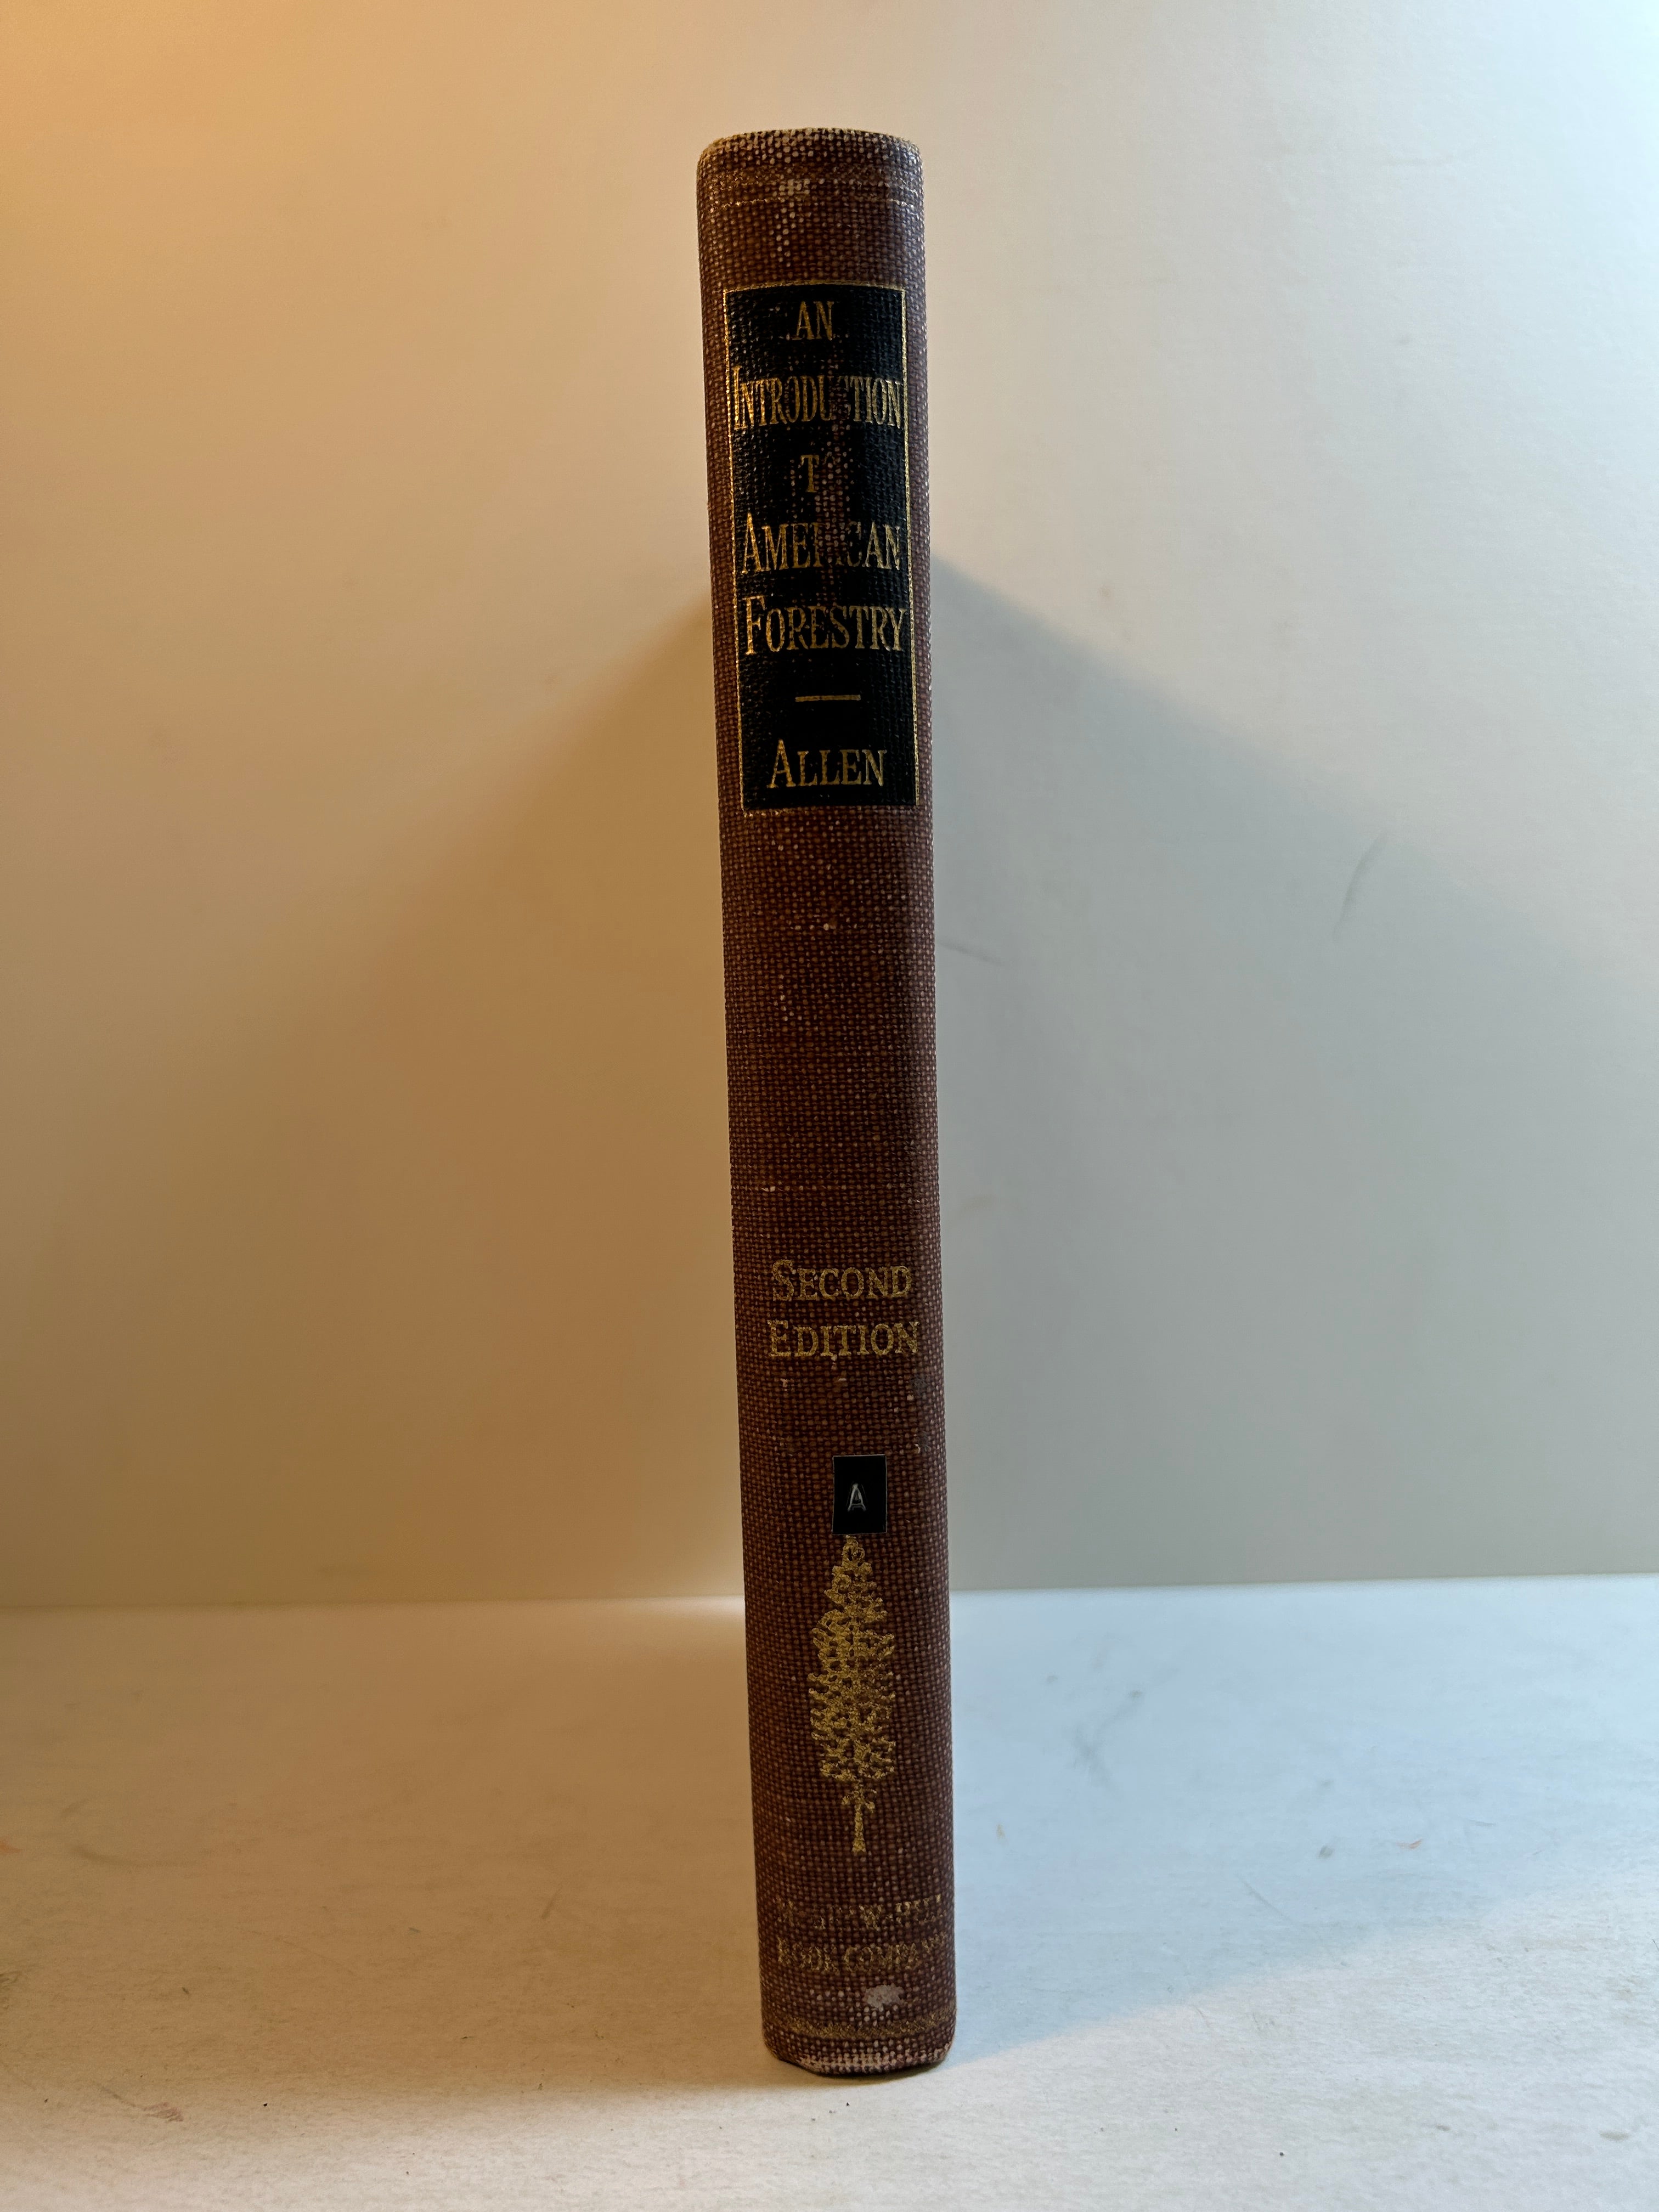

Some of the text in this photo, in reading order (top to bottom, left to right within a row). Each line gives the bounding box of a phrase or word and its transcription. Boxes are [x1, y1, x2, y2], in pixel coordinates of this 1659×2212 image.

[791, 300, 834, 341] AN
[800, 453, 844, 493] T
[741, 512, 901, 575] AMECAN
[741, 595, 909, 655] FORESTRY
[766, 738, 888, 789] ALLEN
[772, 1259, 913, 1302] SECOND
[767, 1319, 921, 1357] EDITION
[847, 1482, 867, 1513] A
